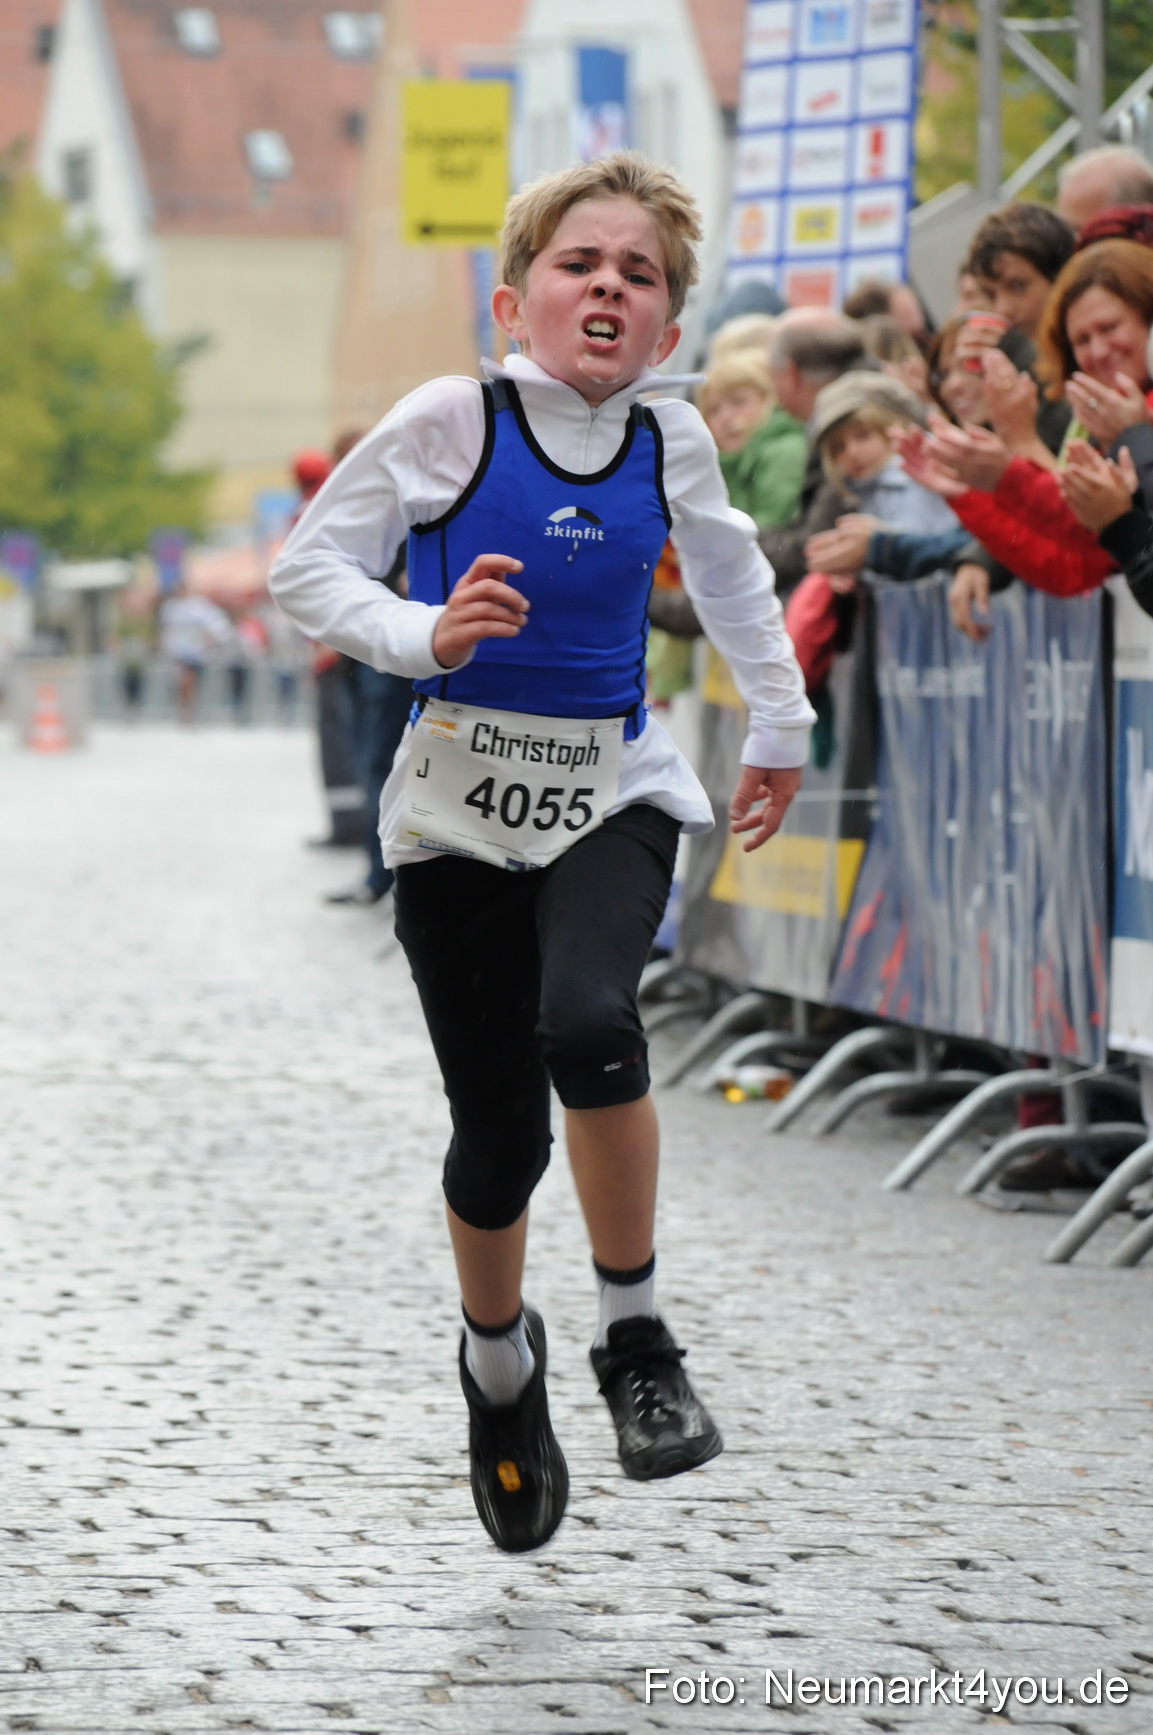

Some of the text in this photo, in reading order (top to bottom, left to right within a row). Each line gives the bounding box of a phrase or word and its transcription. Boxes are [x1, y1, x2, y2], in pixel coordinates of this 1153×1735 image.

[544, 525, 604, 541] skinfit
[471, 722, 600, 772] Christoph
[416, 758, 430, 778] J
[464, 777, 595, 832] 4055
